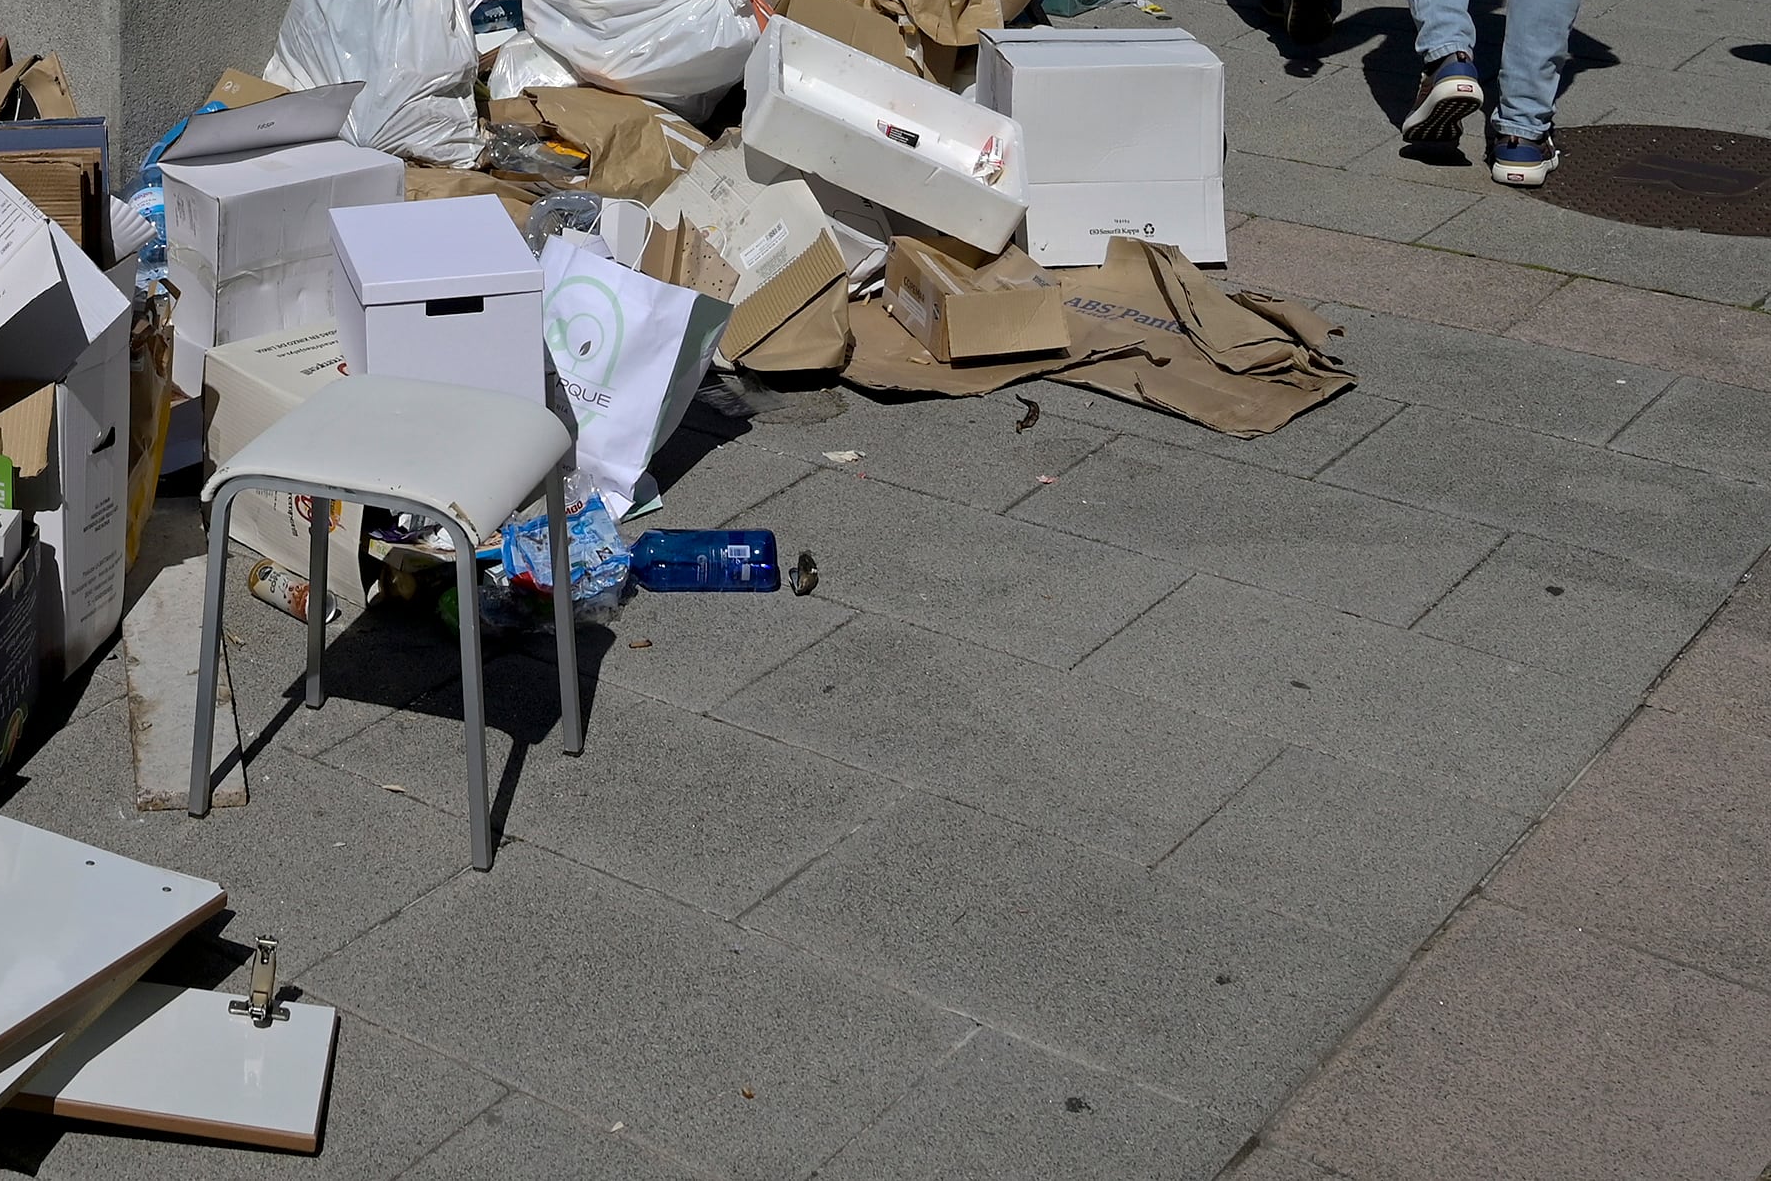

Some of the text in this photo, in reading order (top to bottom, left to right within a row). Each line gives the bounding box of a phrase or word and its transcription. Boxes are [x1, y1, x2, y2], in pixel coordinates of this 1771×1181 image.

[1099, 228, 1140, 236] Smurfit Kappa
[1063, 296, 1116, 315] ABS
